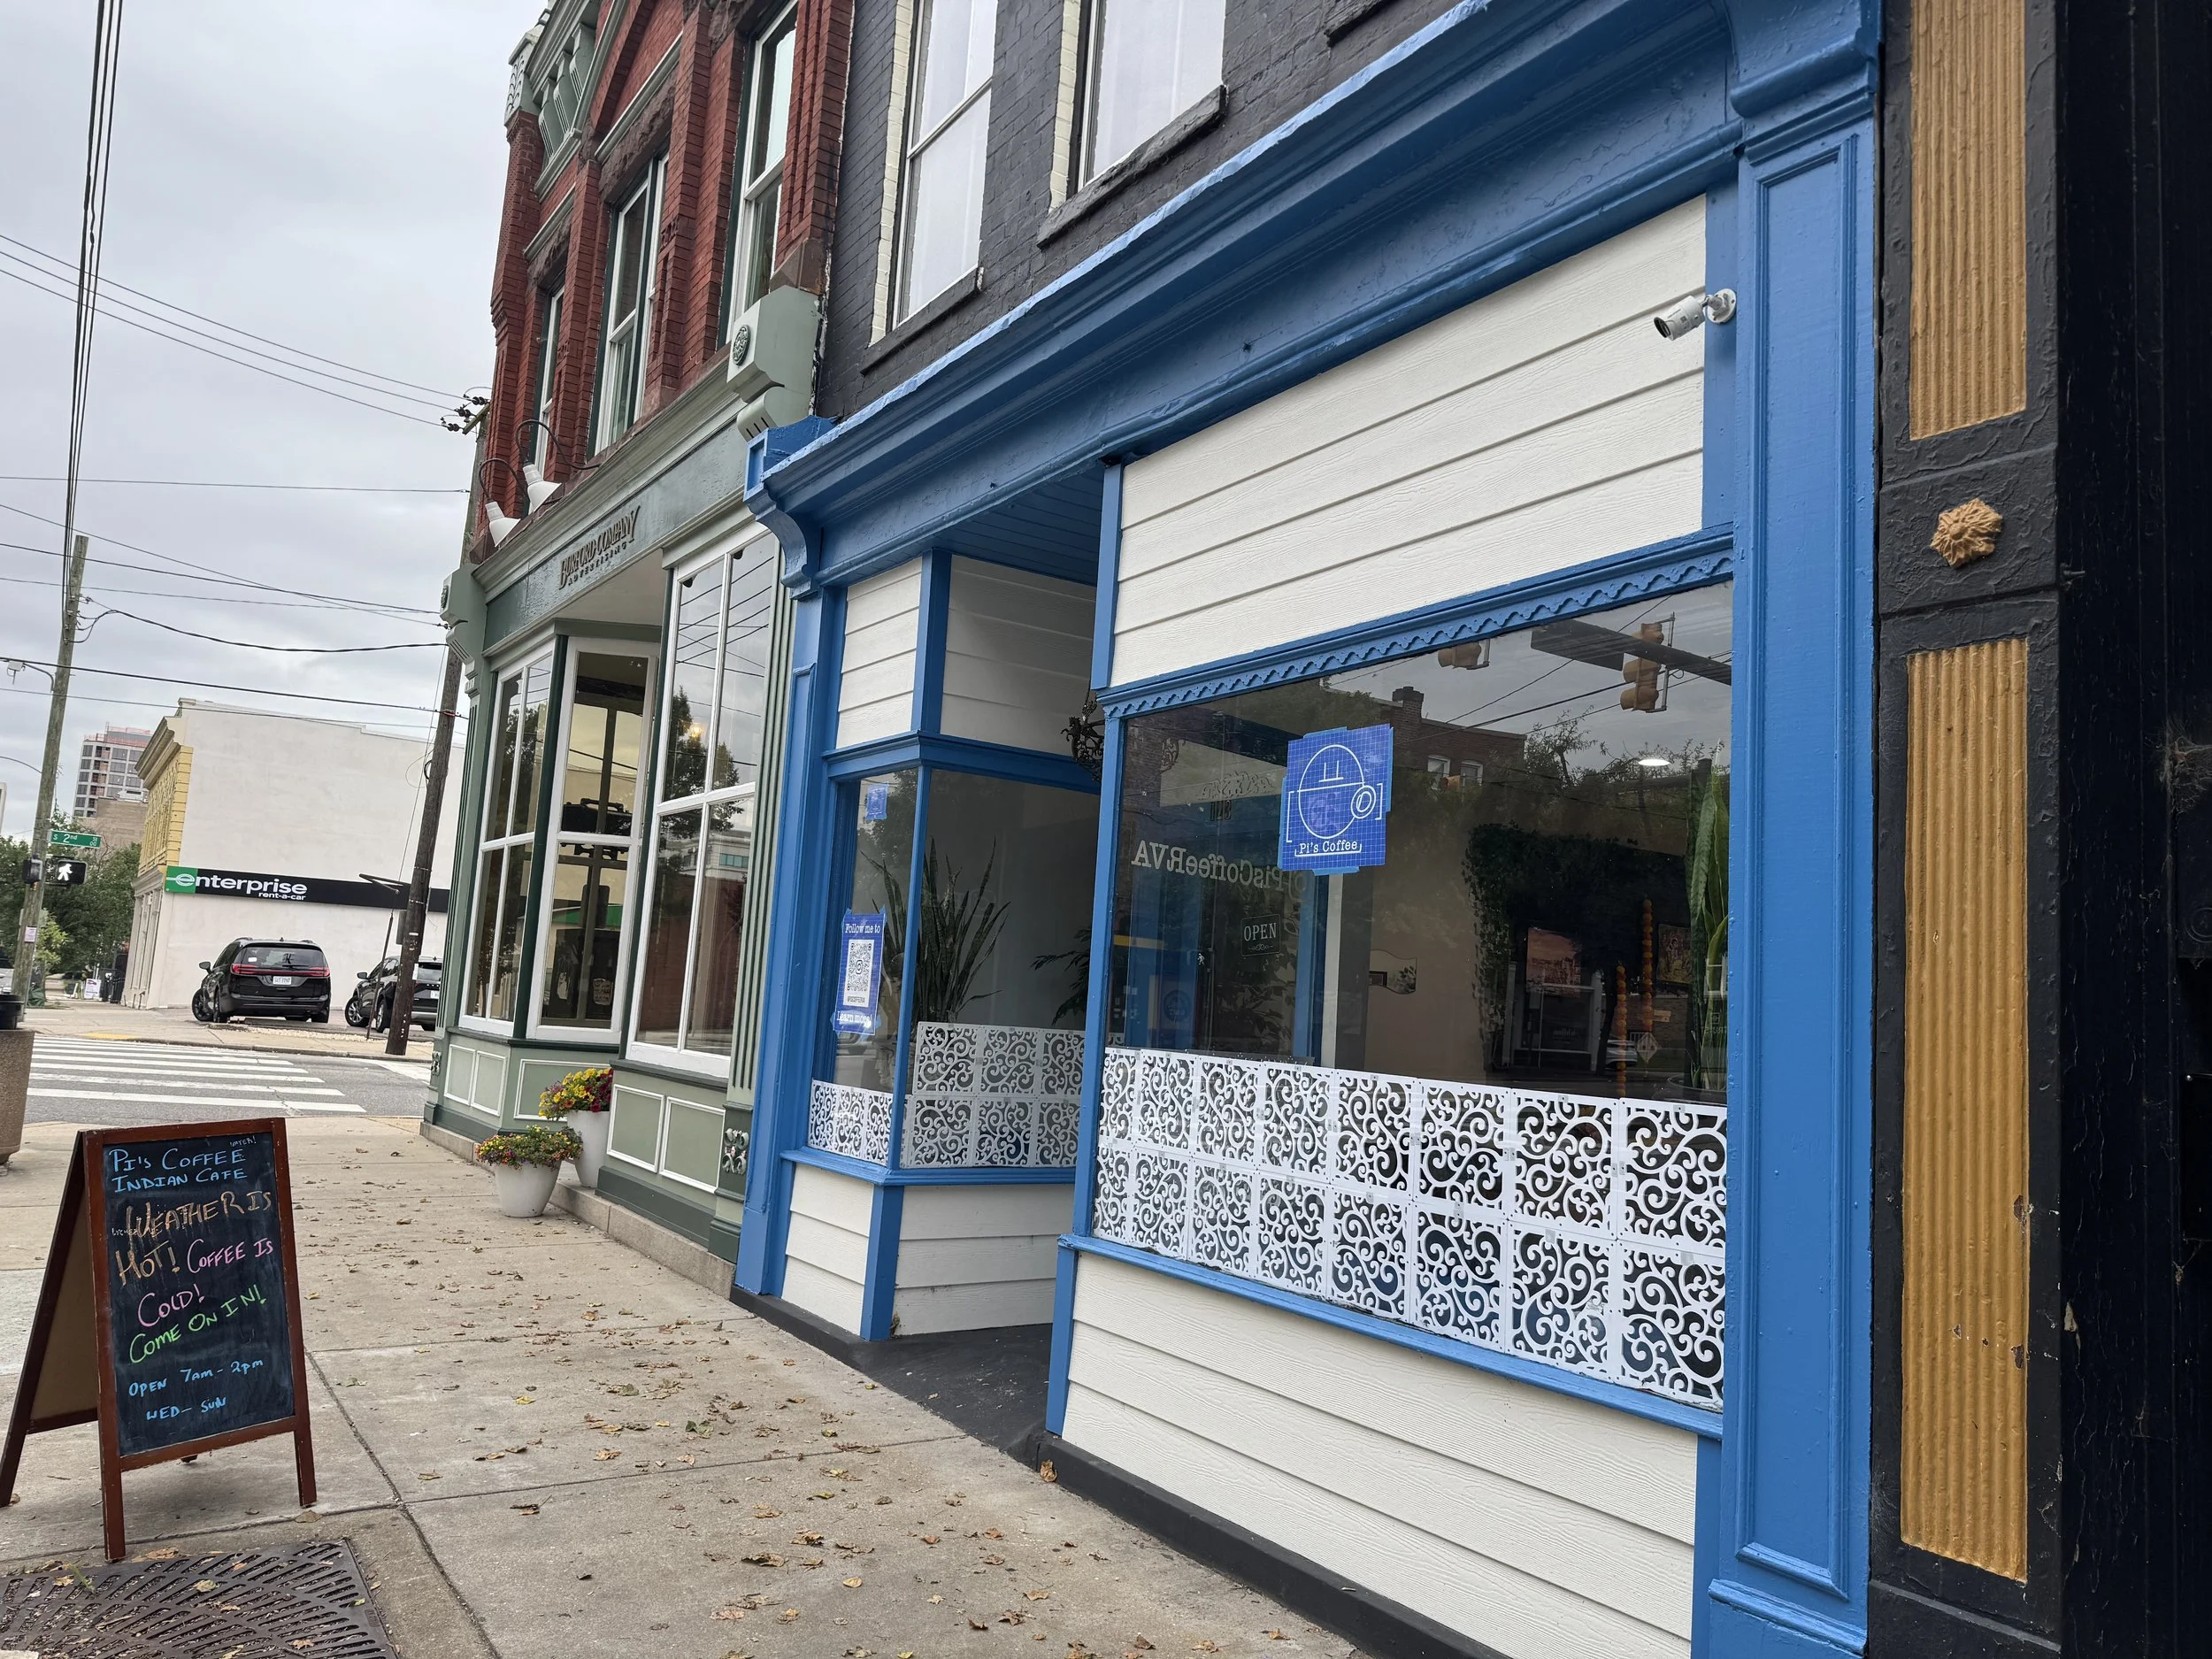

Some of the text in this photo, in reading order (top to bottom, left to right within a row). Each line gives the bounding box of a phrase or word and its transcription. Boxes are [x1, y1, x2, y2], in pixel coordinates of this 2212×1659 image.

[63, 833, 78, 843] 2nd
[1299, 840, 1358, 855] Pi's Coffee
[175, 873, 308, 895] enterprise
[258, 891, 306, 901] rent-a-car
[845, 923, 864, 933] Follow
[874, 924, 881, 934] to
[1243, 922, 1277, 942] OPEN
[836, 1010, 854, 1023] Learn
[162, 1148, 246, 1170] COFFEE
[111, 1168, 247, 1193] INDIAN CAFE
[126, 1191, 272, 1238] WEATHER IS
[115, 1238, 273, 1286] HOT! COFFEE IS
[138, 1284, 205, 1327] COLD!
[129, 1284, 266, 1363] COME ON IN!
[128, 1378, 167, 1397] OPEN
[230, 1359, 264, 1375] 2pm
[201, 1396, 227, 1413] SUN
